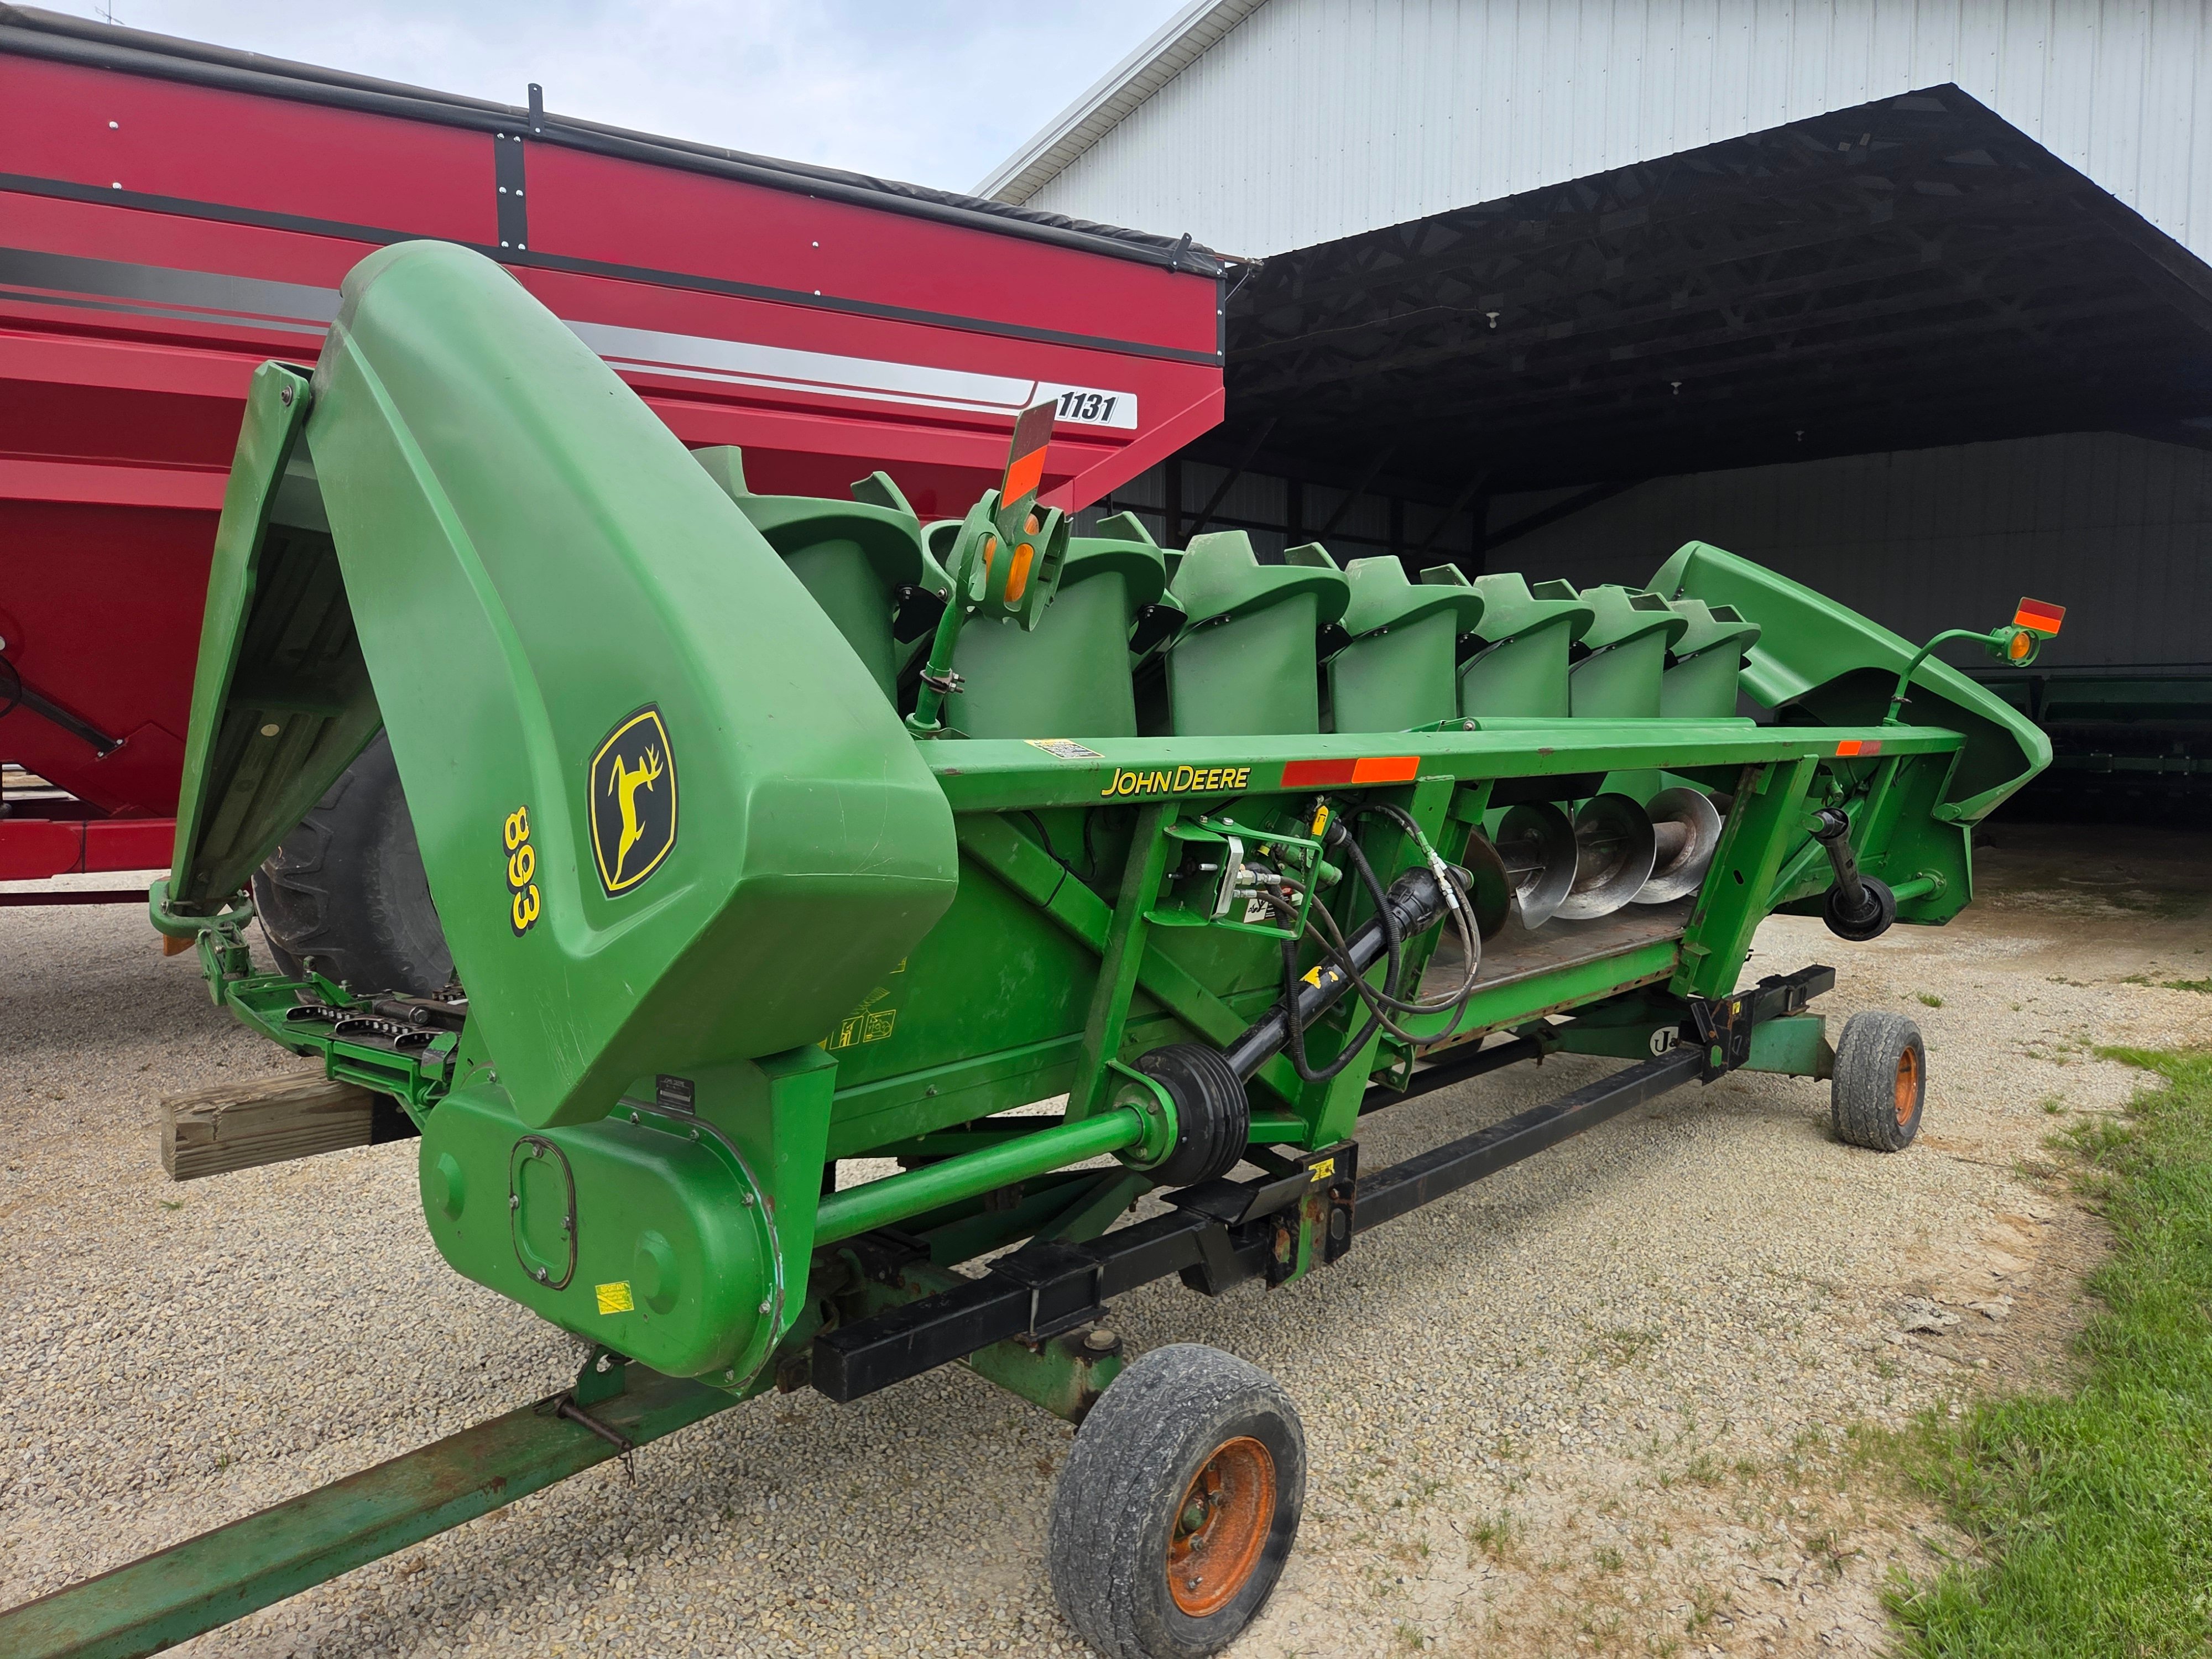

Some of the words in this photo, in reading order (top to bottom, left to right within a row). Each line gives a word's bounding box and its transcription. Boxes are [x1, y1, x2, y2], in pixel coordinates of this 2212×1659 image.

[1058, 391, 1118, 422] 1131
[1100, 766, 1173, 797] JOHN
[1172, 765, 1251, 792] DEERE
[503, 805, 541, 936] 893
